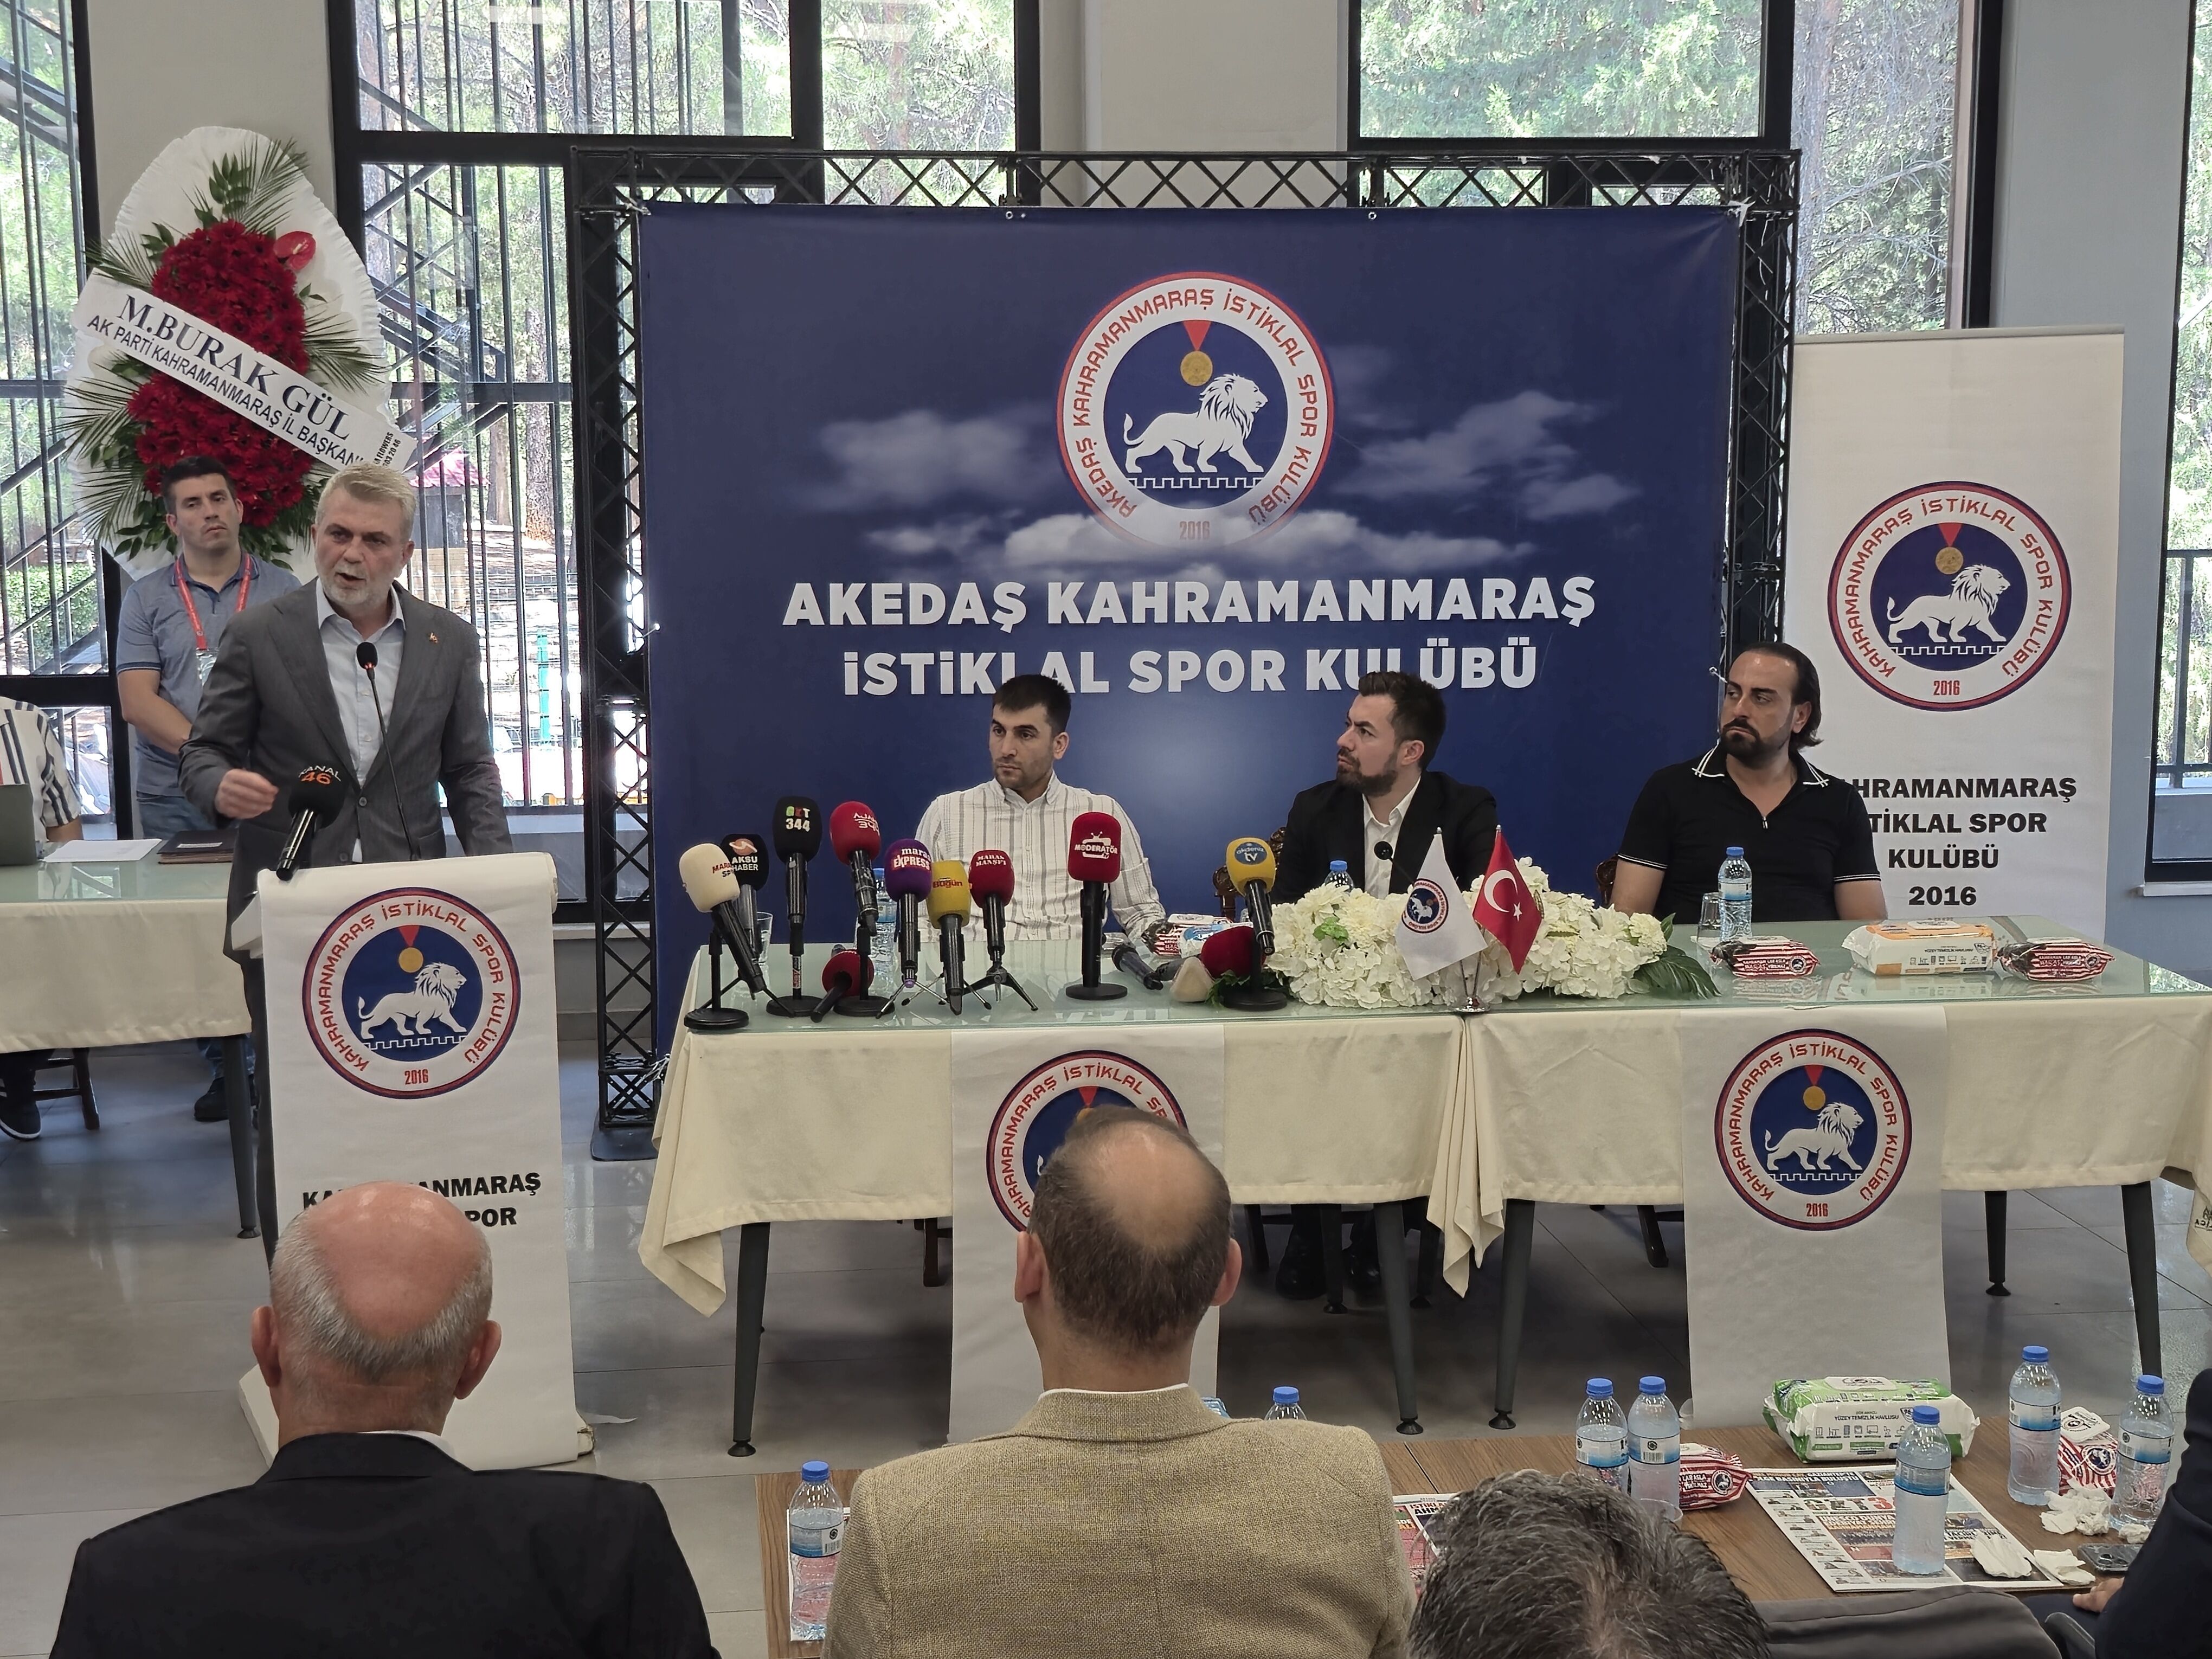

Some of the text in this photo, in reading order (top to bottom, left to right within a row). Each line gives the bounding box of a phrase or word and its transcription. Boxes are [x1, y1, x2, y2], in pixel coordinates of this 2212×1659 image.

[117, 294, 351, 440] M.BURAK GÜL
[87, 314, 364, 466] AK PARTİ KAHRAMANMARAŞ İL BAŞKAN
[1073, 288, 1317, 525] AKEDAŞ KAHRAMANMARAŞ İSTİKLAL SPOR KULÜBÜ
[377, 432, 394, 459] FLOWERS
[388, 447, 396, 457] 20
[393, 439, 401, 450] 46
[1179, 520, 1210, 540] 2016
[1844, 495, 2053, 678] KAHRAMANMARAŞ İSTİKLAL SPOR KULÜBÜ
[783, 577, 1594, 633] AKEDAŞ KAHRAMANMARAŞ
[1129, 649, 1285, 692] SPOR
[1933, 680, 1960, 696] 2016
[298, 766, 341, 781] KANAL
[301, 772, 331, 784] 46
[1851, 777, 2076, 802] HRAMANMARAŞ
[786, 818, 810, 832] 344
[1867, 808, 2047, 833] TİKLAL SPOR
[1075, 844, 1118, 854] MODERATÖR
[1244, 852, 1258, 861] tv
[1889, 844, 1999, 869] KULÜBÜ
[712, 863, 731, 873] MARA
[893, 855, 930, 870] EXPRESS
[1909, 886, 1977, 905] 2016
[319, 900, 505, 1071] KAHRAMANMARAŞ İSTİKLAL SPOR KULÜBÜ
[404, 1069, 428, 1085] 2016
[1729, 1041, 1898, 1201] KAHRAMANMARAŞ İSTİKLAL SPOR KULÜBÜ
[1001, 1062, 1169, 1218] AHRAMANMARAŞ İSTİKLAL SP
[464, 1207, 517, 1227] POR
[1806, 1203, 1828, 1217] 2016
